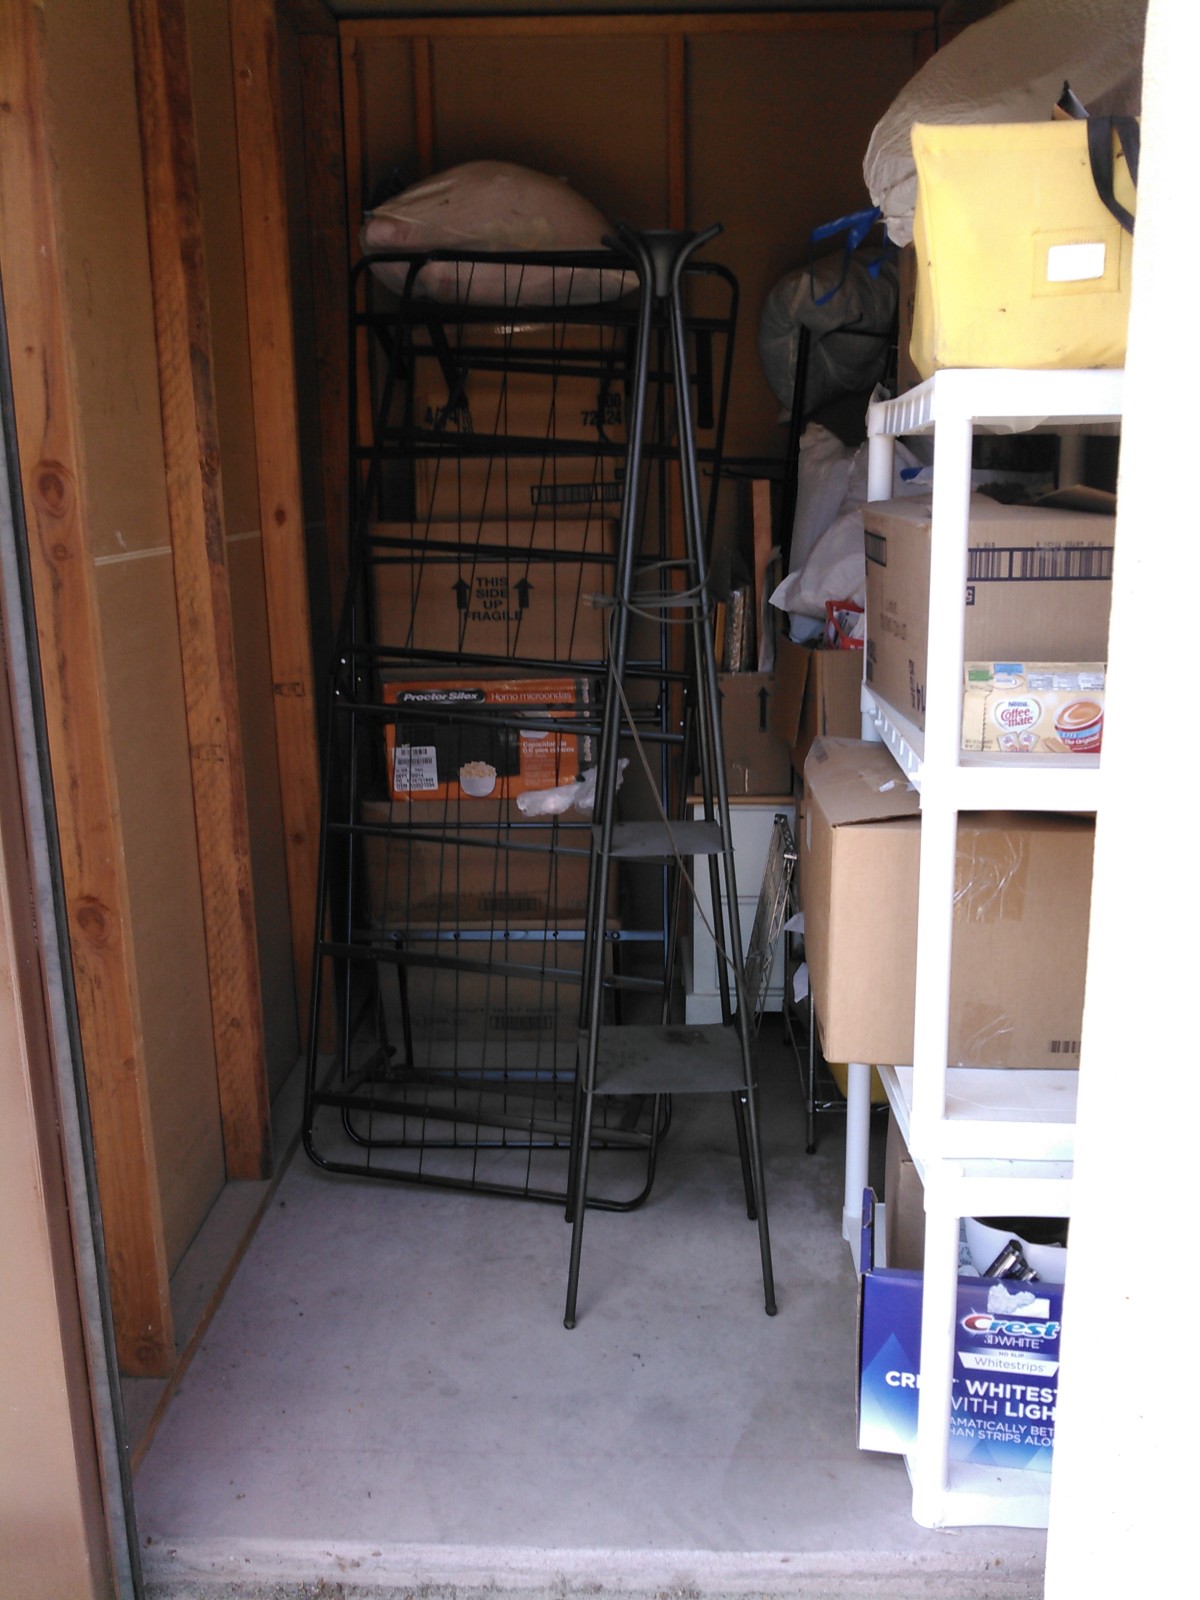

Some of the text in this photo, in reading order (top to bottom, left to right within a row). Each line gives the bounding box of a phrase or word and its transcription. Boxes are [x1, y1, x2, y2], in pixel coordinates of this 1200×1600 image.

[476, 577, 508, 587] THIS
[476, 589, 508, 598] SIDE
[483, 600, 502, 609] UP
[464, 610, 522, 621] FRAGILE
[403, 692, 479, 701] Proctor Silex
[521, 691, 572, 700] microondas
[963, 1314, 1060, 1340] Crest
[975, 1357, 1045, 1372] Whitestrips
[1005, 1401, 1056, 1421] LIGH
[951, 1416, 1027, 1434] AMATICALLY
[978, 1430, 1021, 1443] STRIPS
[1024, 1436, 1054, 1447] ALO
